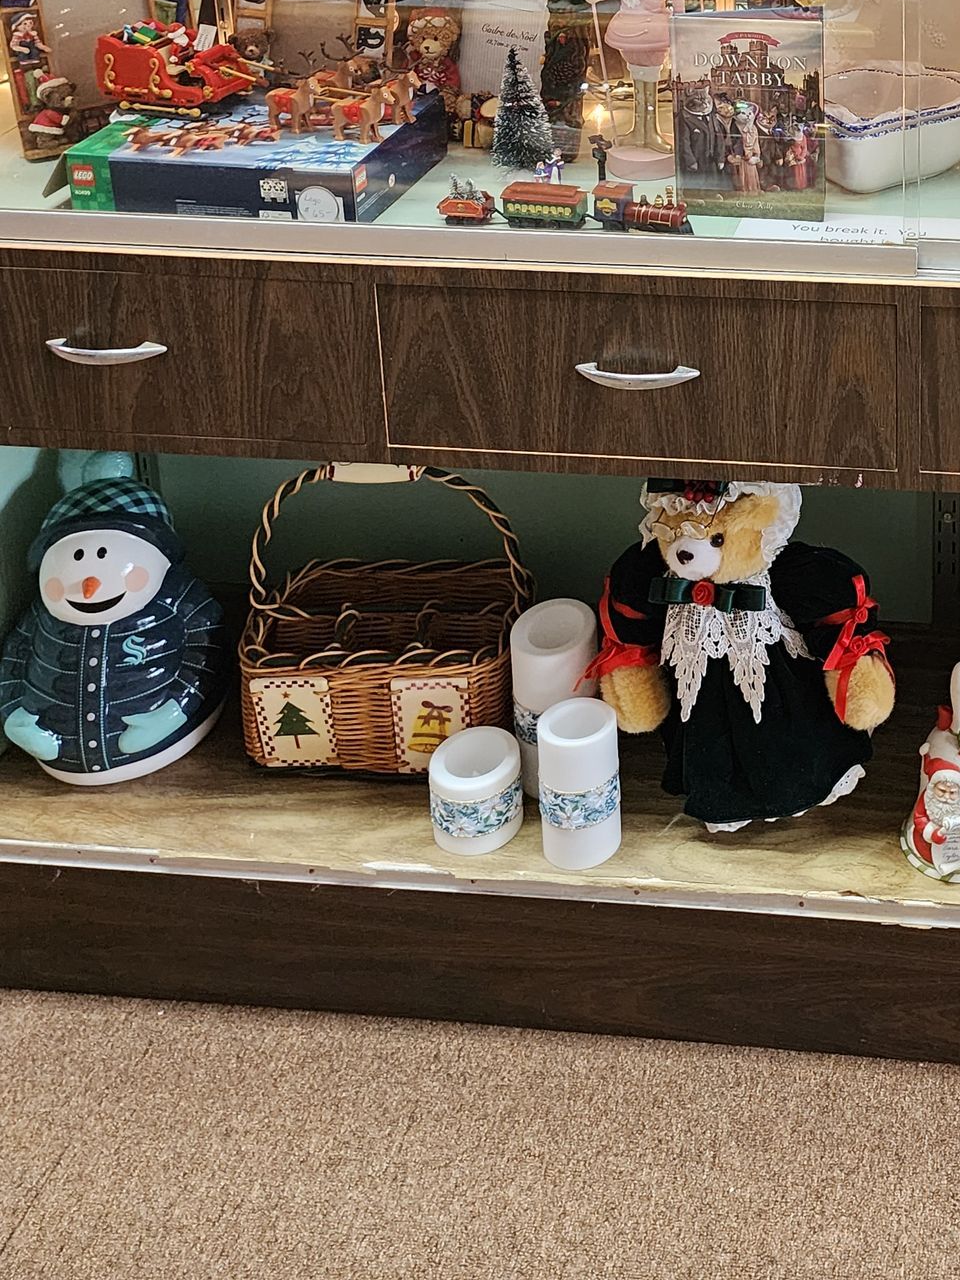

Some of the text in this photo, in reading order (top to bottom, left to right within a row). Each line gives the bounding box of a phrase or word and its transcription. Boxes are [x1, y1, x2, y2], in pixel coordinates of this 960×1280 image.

[481, 23, 538, 43] Cadre de Noël
[693, 52, 808, 70] DOWNTON
[717, 71, 785, 87] TABBY
[72, 169, 94, 181] LEGO
[791, 223, 927, 237] You break it. You
